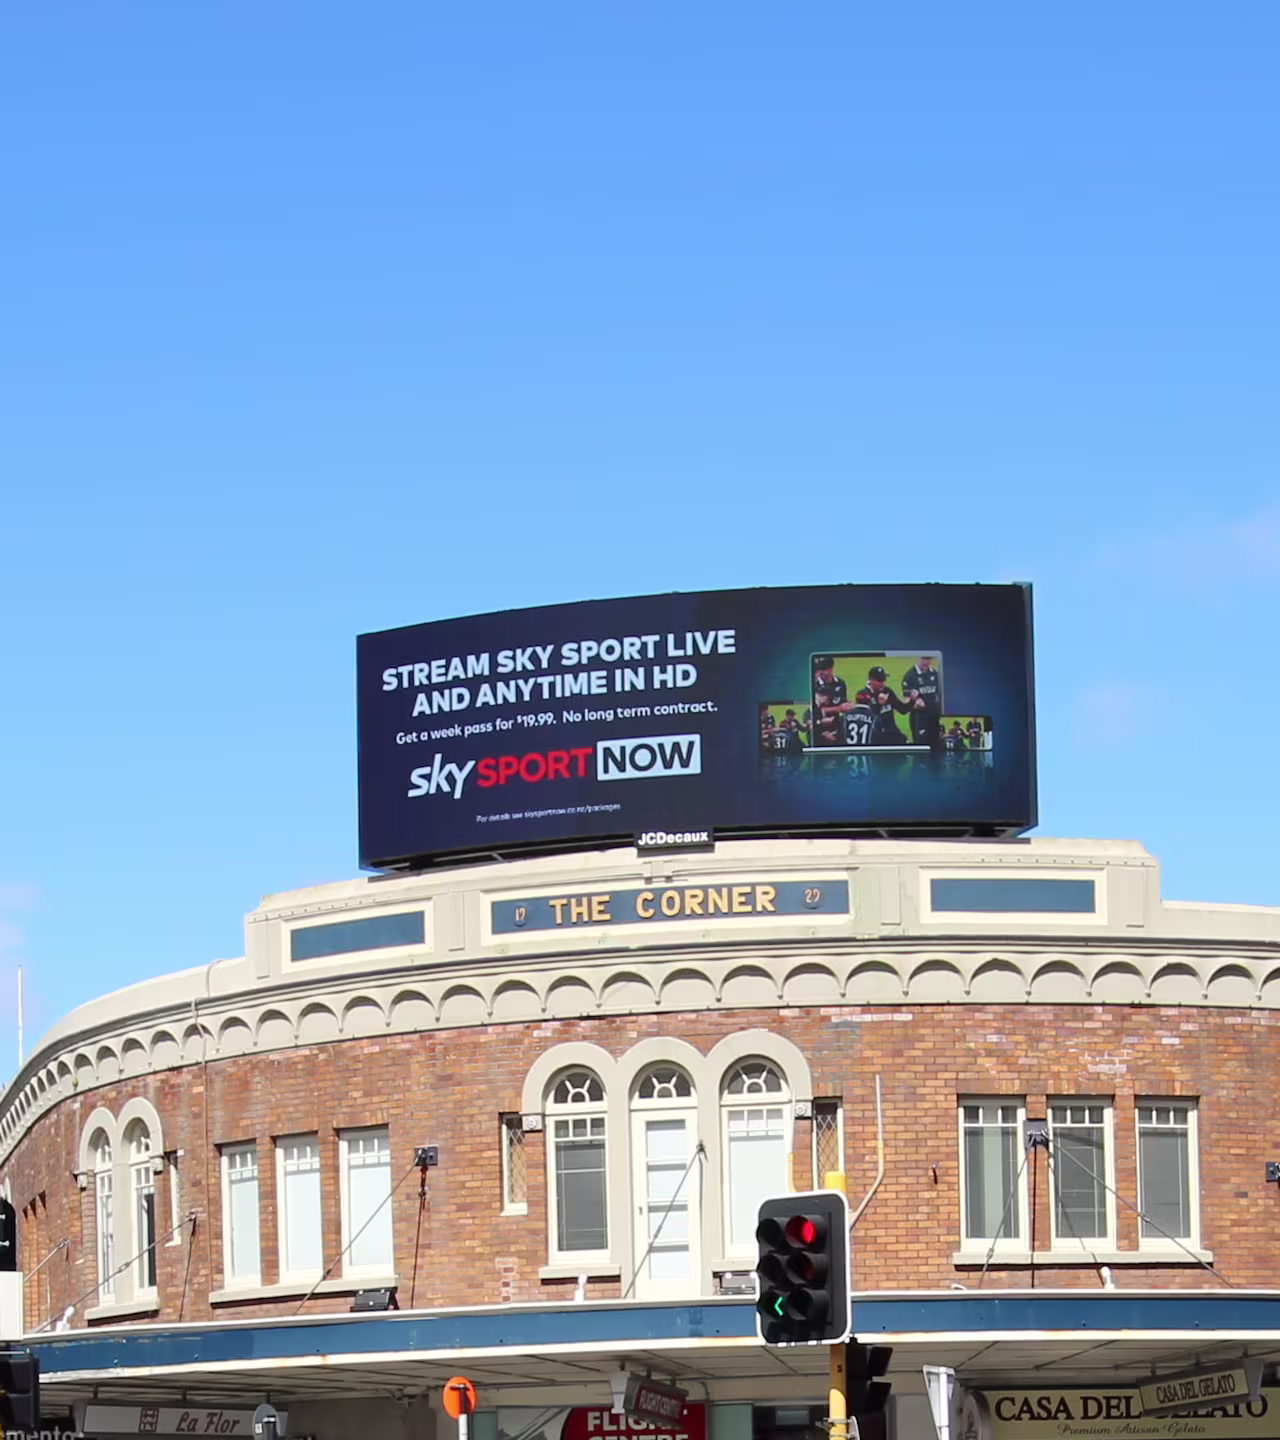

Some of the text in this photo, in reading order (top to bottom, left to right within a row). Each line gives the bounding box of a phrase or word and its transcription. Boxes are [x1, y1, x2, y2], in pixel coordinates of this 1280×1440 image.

[382, 629, 736, 691] STREAM SKY SPORT LIVE
[412, 663, 697, 717] AND ANYTIME IN HD
[396, 732, 418, 745] Get
[420, 732, 428, 742] a
[430, 723, 462, 741] week
[464, 722, 493, 739] pass
[495, 717, 514, 731] for
[563, 708, 582, 723] No
[584, 707, 614, 724] long
[617, 704, 651, 719] term
[654, 700, 718, 716] contract.
[847, 723, 868, 745] 31
[407, 740, 696, 800] sky SPORT NOW
[638, 830, 709, 847] JCDecaux
[549, 895, 612, 926] THE
[635, 885, 776, 919] CORNER
[1156, 1374, 1236, 1404] CASA DEL GELATO
[995, 1396, 1074, 1421] CASA
[1080, 1395, 1142, 1421] DEL
[175, 1413, 197, 1433] La
[204, 1412, 240, 1435] Flor
[1057, 1422, 1111, 1436] Premium
[1162, 1421, 1206, 1437] Gelato
